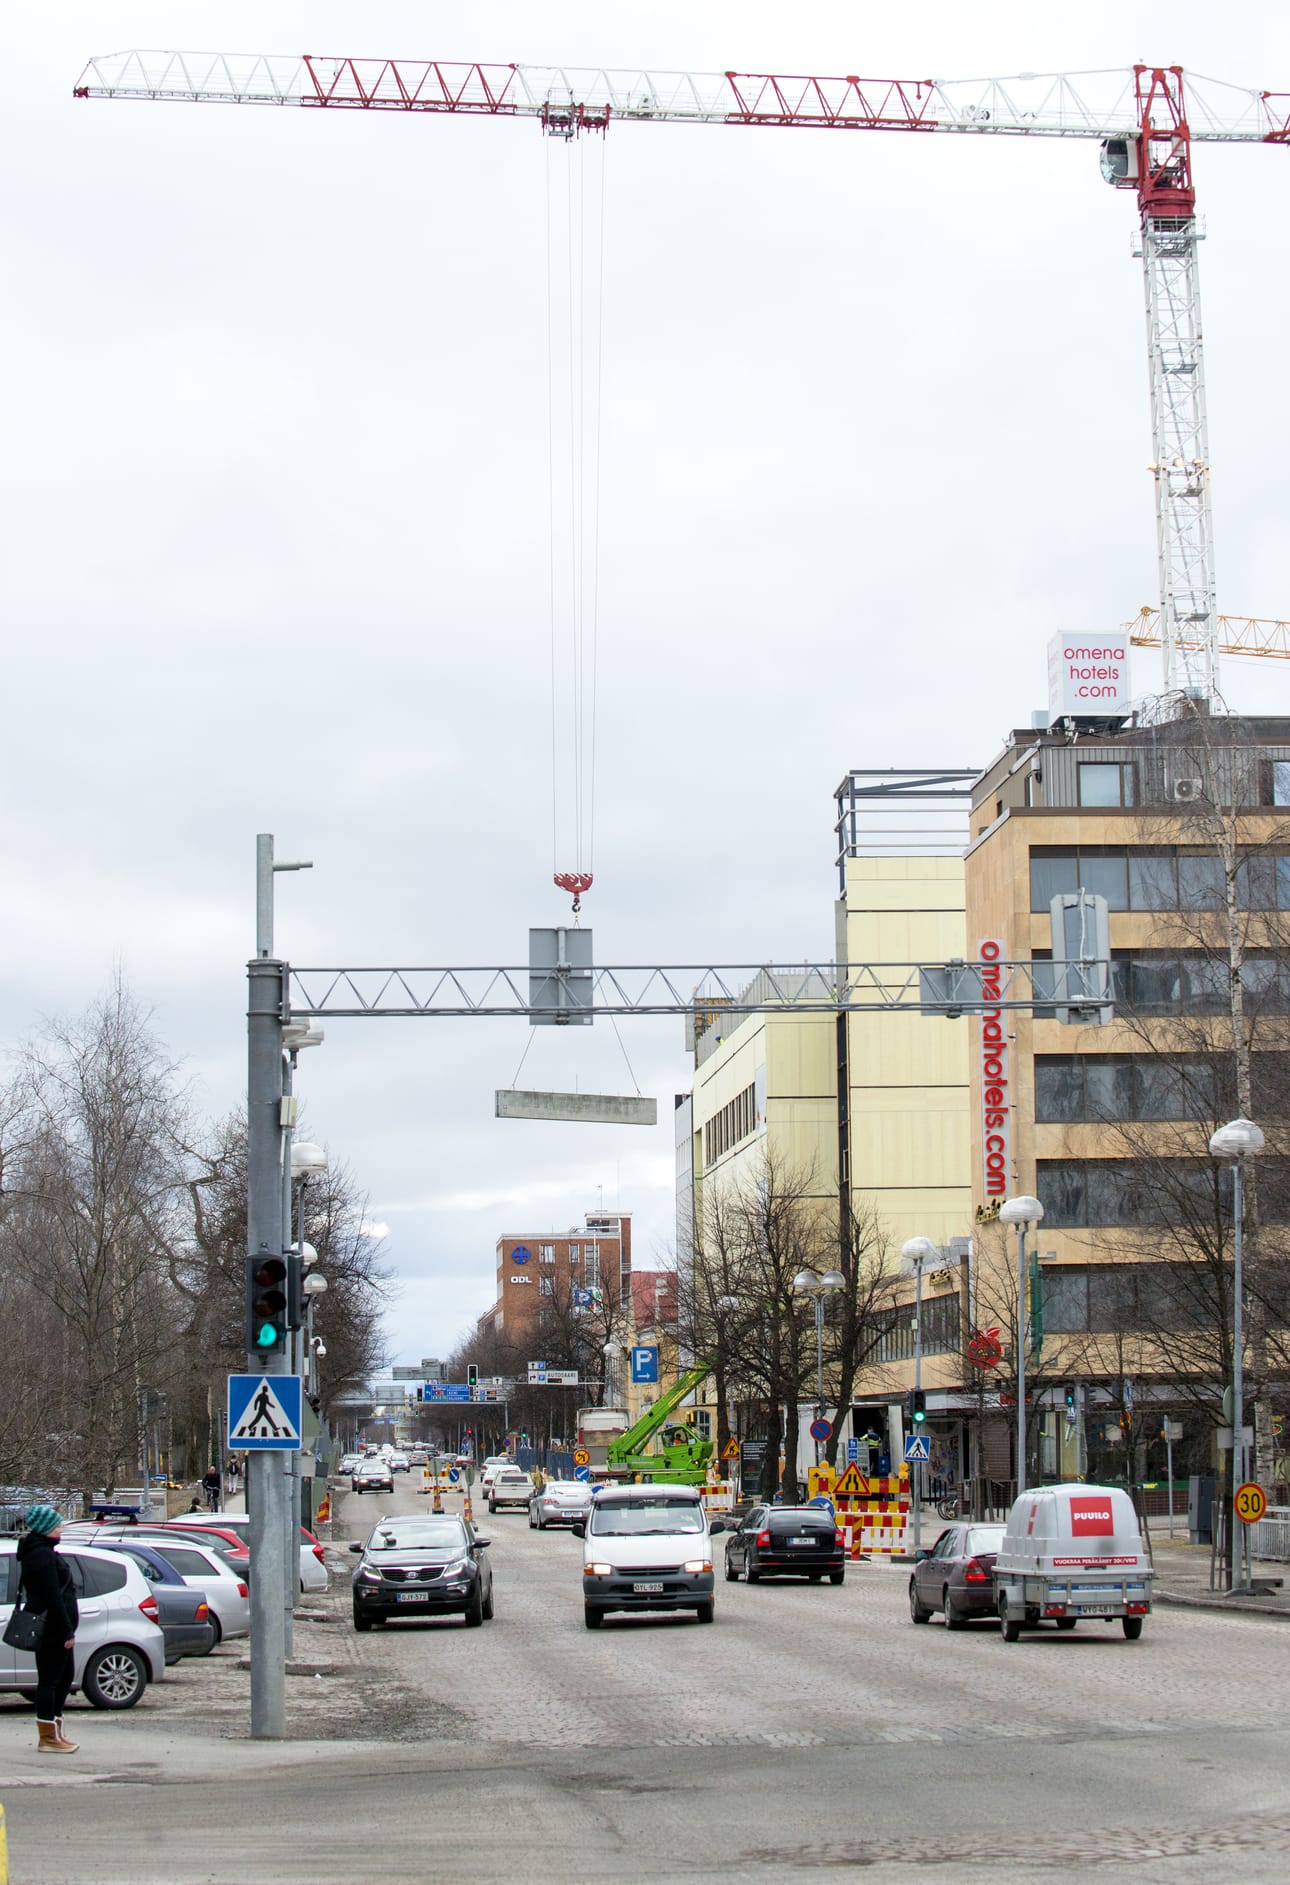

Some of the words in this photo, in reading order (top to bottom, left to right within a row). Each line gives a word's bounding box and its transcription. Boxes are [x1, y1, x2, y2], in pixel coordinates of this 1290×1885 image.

[1063, 648, 1124, 660] omena
[1070, 665, 1119, 680] hotels
[1074, 686, 1117, 698] .com
[510, 1276, 532, 1284] ODL
[636, 1350, 652, 1371] P
[1240, 1493, 1260, 1513] 30
[1073, 1512, 1110, 1520] PUUILO
